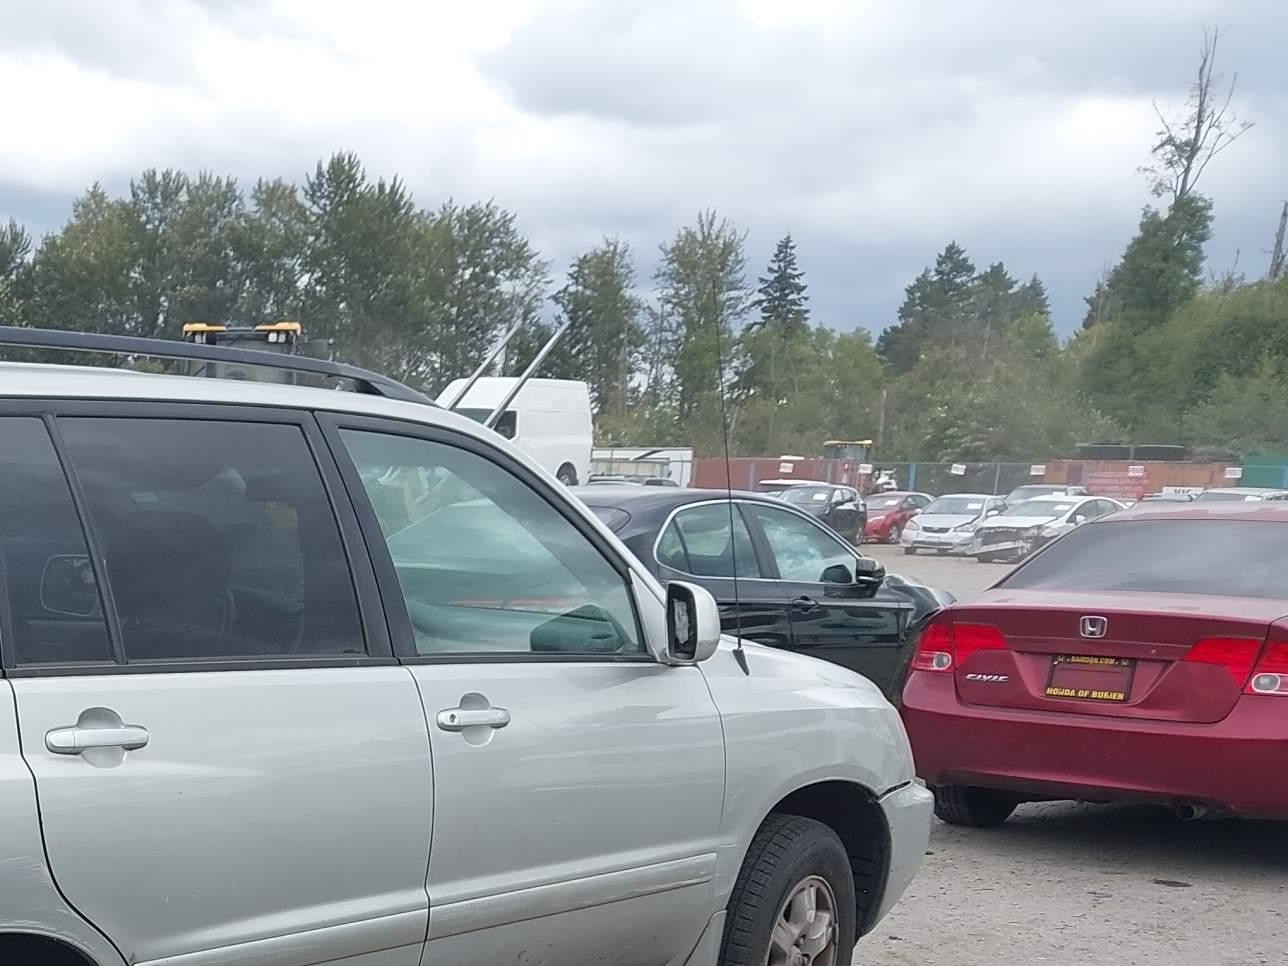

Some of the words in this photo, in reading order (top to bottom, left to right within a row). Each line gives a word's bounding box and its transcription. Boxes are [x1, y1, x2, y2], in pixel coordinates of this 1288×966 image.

[966, 673, 1009, 682] CIVIC
[1046, 687, 1076, 696] HONDA
[1077, 690, 1090, 698] OF
[1091, 690, 1125, 700] BURIEN
